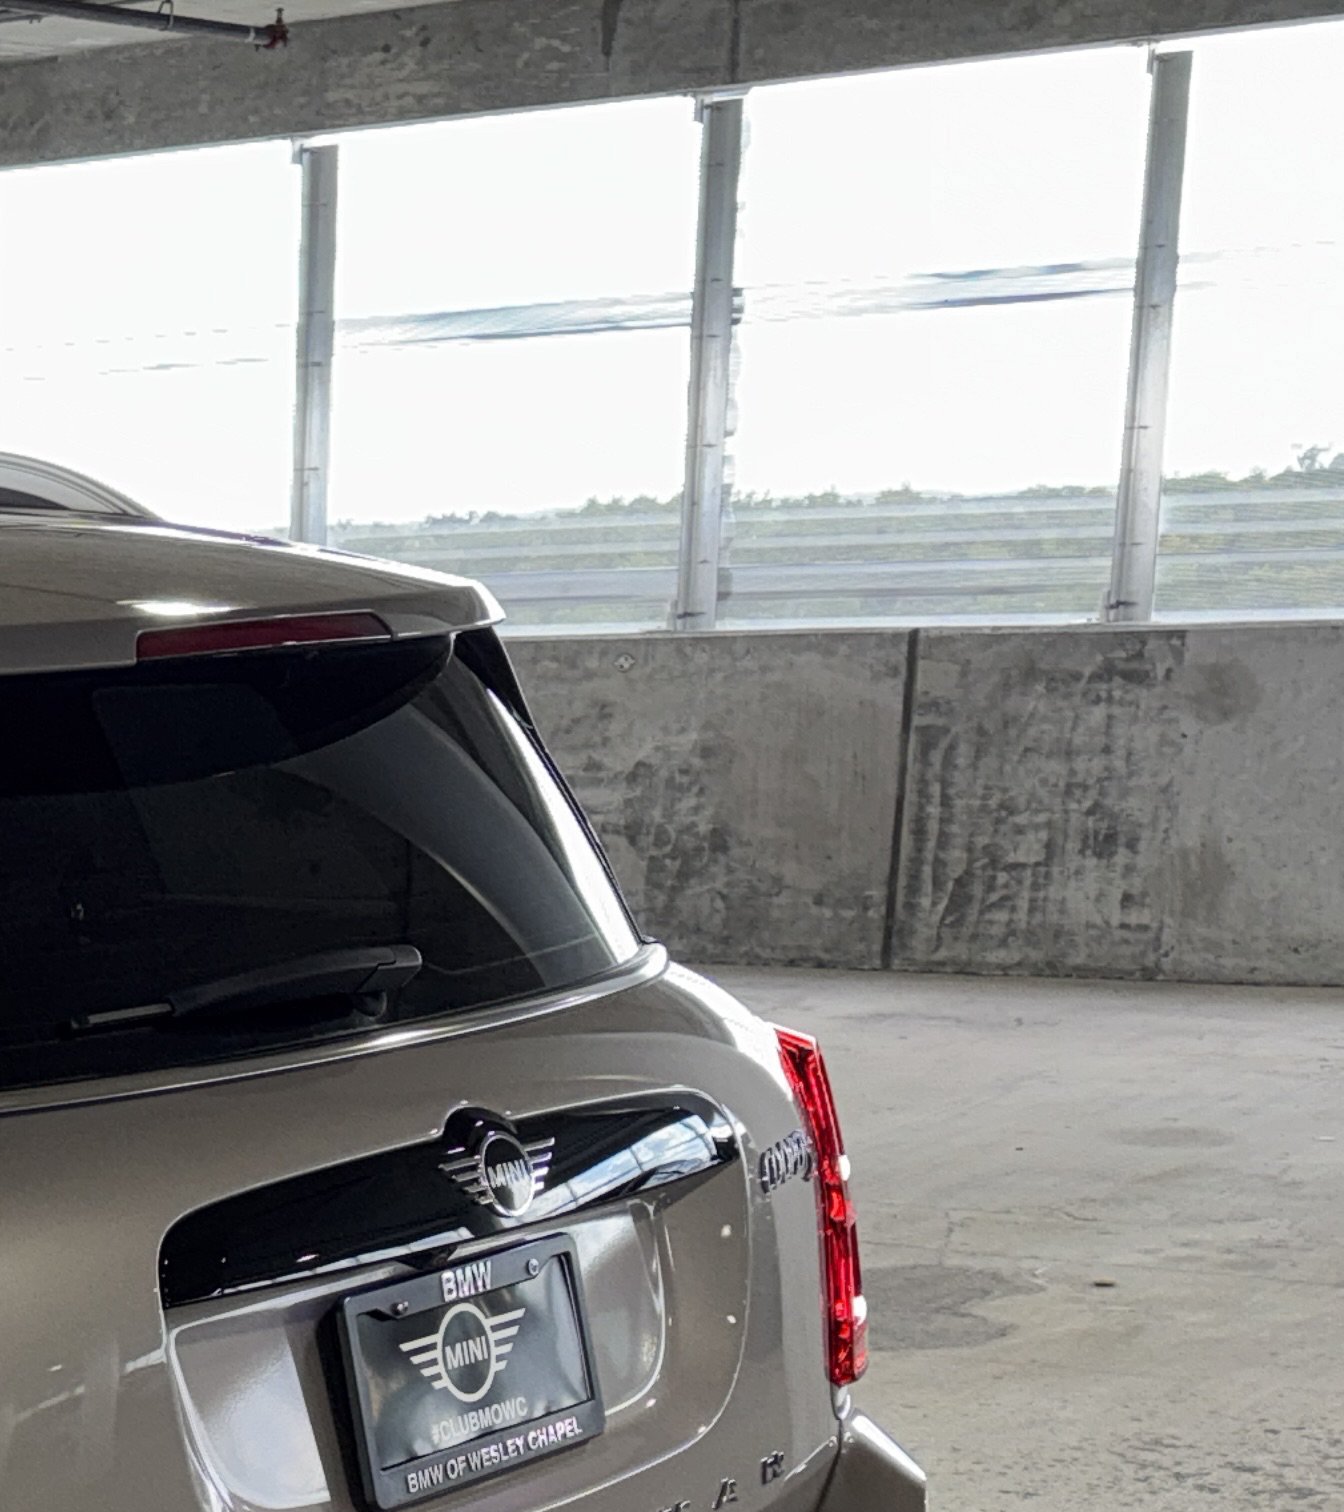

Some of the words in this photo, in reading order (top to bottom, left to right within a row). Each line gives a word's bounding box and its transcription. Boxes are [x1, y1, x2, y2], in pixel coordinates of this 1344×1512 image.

[488, 1159, 530, 1189] MINI
[440, 1260, 492, 1302] BMW
[444, 1336, 489, 1370] MINI
[431, 1396, 528, 1445] #CLUBMOWC
[407, 1463, 444, 1493] BMW
[447, 1455, 468, 1480] OF
[468, 1436, 526, 1472] WESLEY
[527, 1416, 583, 1450] CHAPEL
